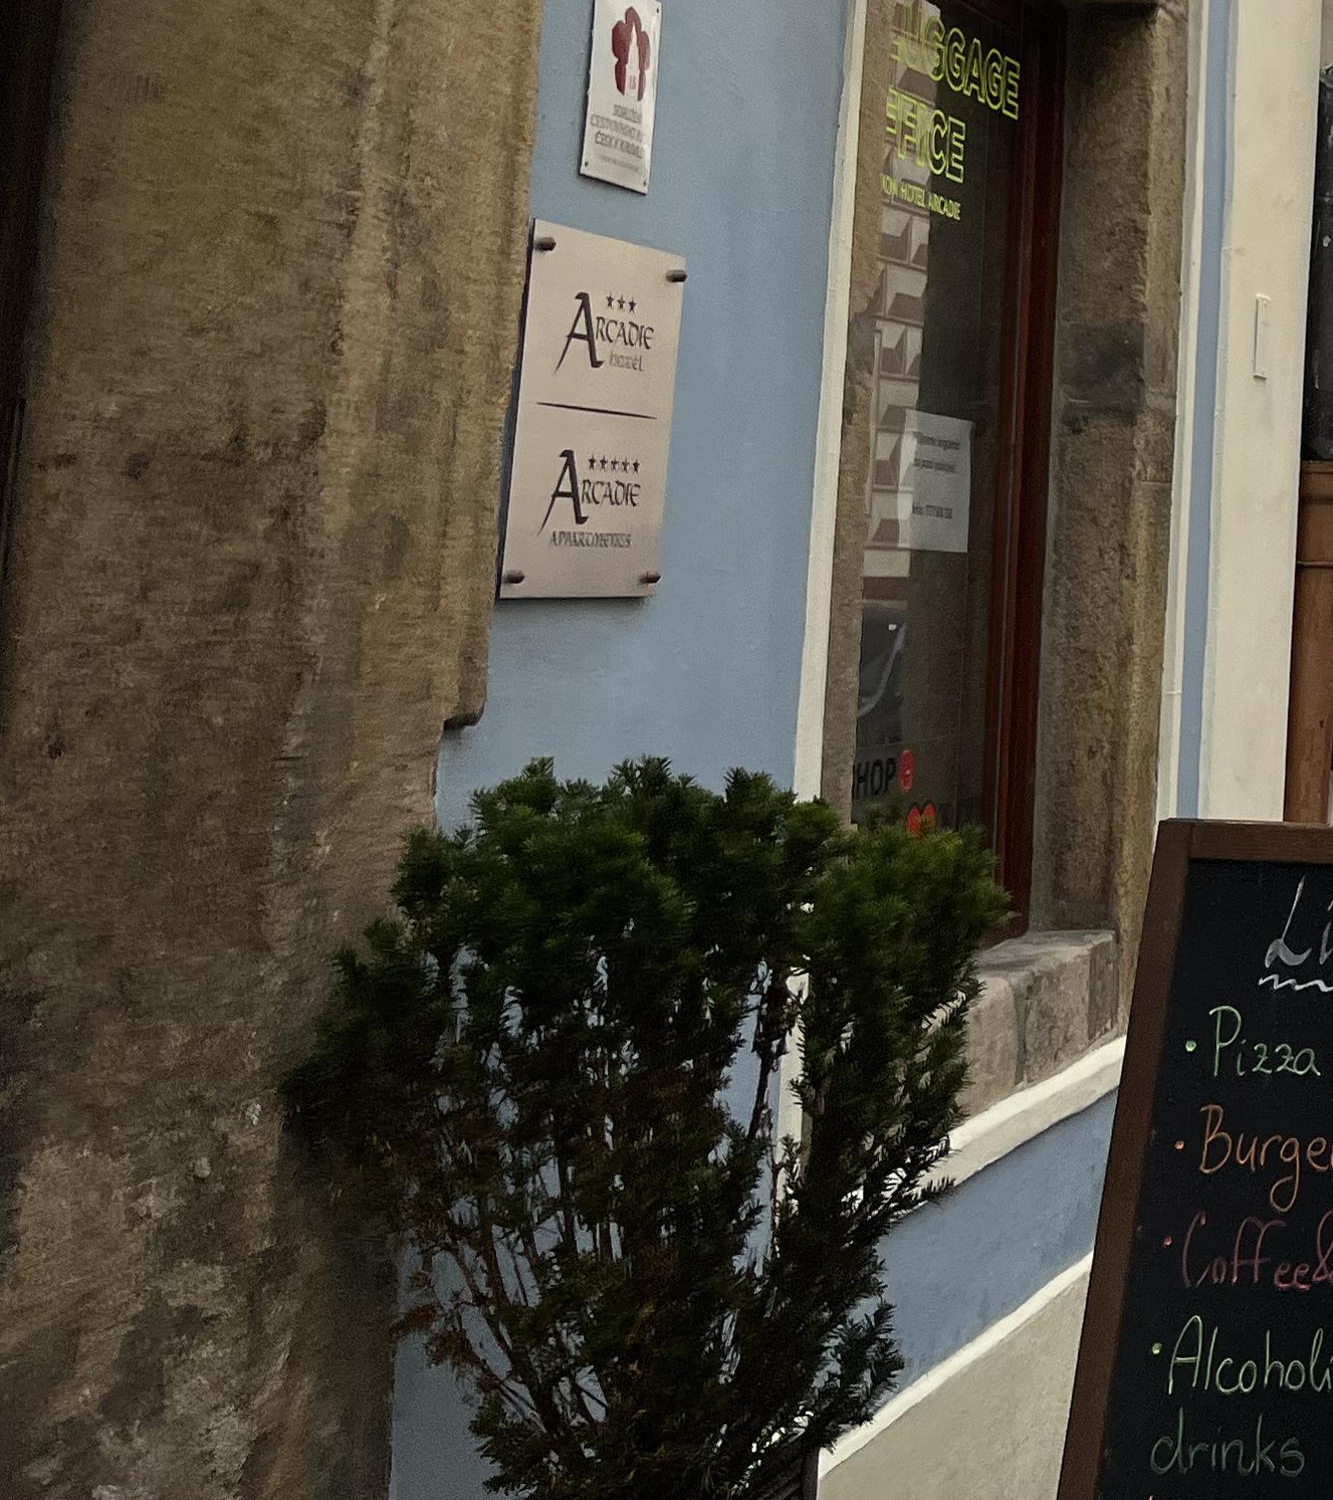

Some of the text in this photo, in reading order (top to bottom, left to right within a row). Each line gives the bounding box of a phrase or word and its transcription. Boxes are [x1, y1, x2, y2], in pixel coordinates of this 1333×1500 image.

[553, 290, 655, 375] ARCADIE
[537, 448, 642, 536] ARCADIE
[852, 756, 897, 799] HOP
[1208, 1005, 1322, 1079] Pizza
[1149, 1407, 1307, 1477] drinks
